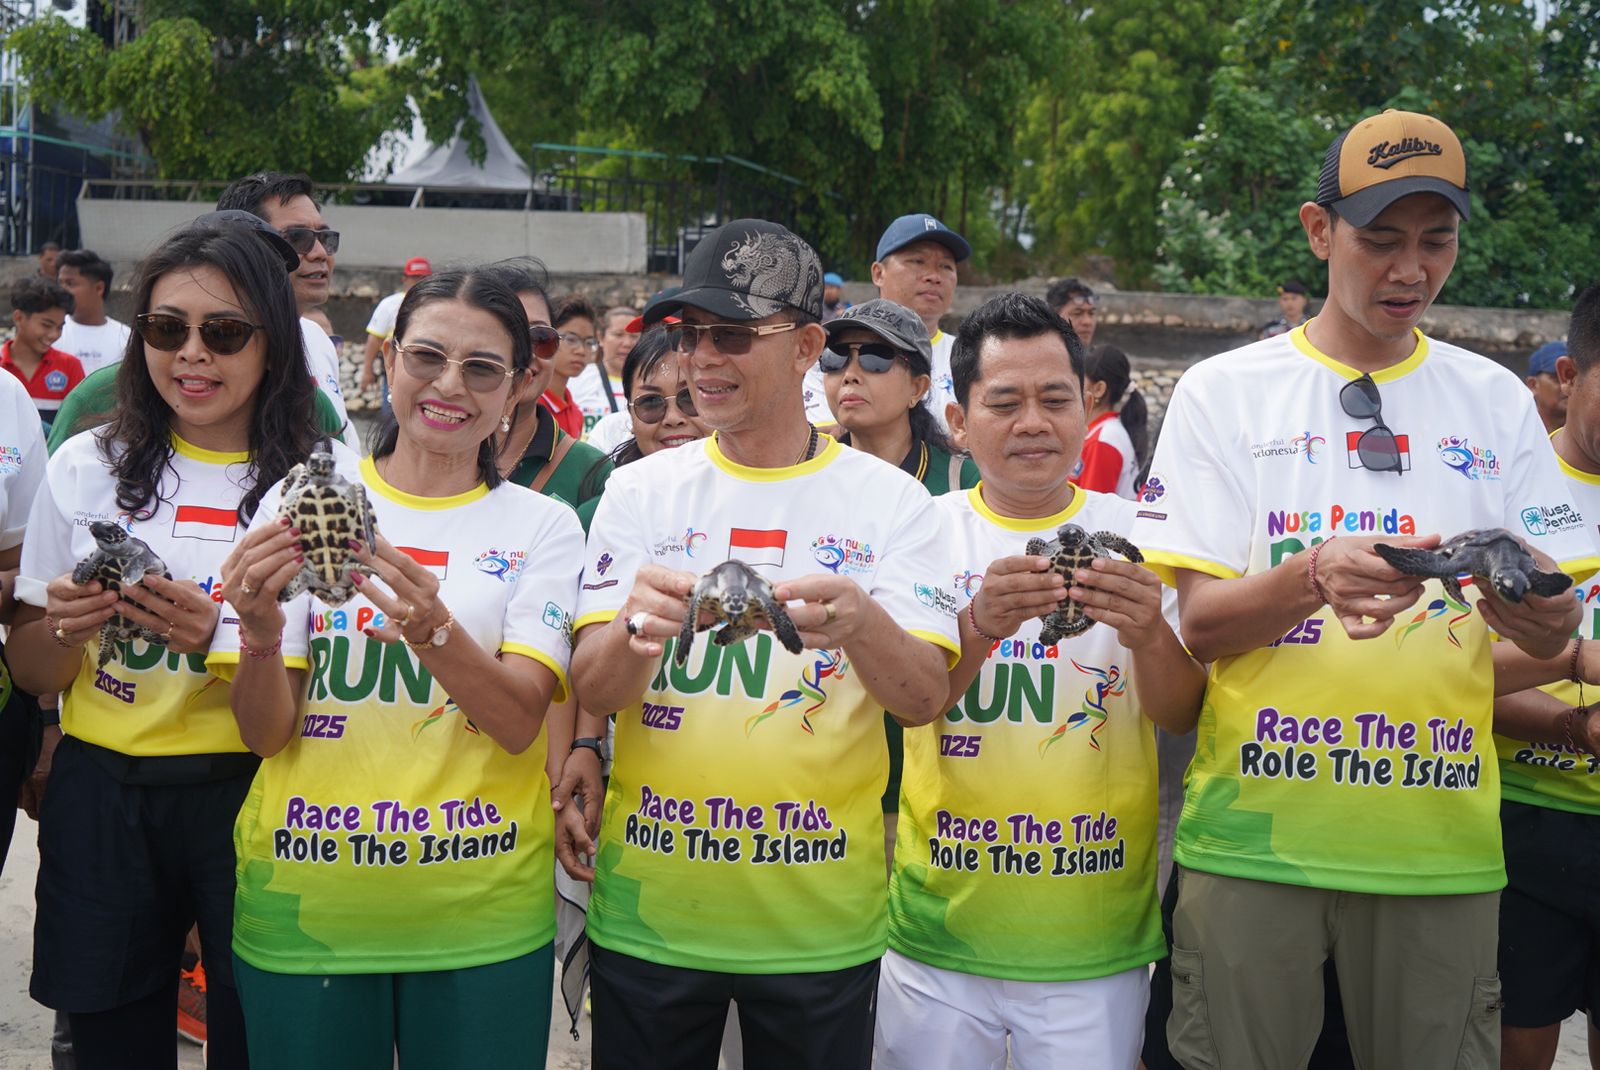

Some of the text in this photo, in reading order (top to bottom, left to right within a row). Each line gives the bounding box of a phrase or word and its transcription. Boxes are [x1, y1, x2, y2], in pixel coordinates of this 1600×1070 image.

[1367, 137, 1443, 165] Kalibre
[73, 510, 110, 520] onderful
[1268, 504, 1415, 537] Nusa Penida
[1541, 503, 1571, 518] Nusa
[1558, 523, 1585, 533] Tomorro
[94, 668, 137, 704] 2025
[308, 635, 434, 705] RUN
[945, 662, 1056, 724] UN
[939, 734, 983, 758] 025
[1256, 707, 1474, 753] Race The Tide
[1240, 742, 1480, 789] Role The Island
[286, 796, 502, 833] Race The Tide
[637, 785, 833, 832] Race The Tide
[936, 809, 1117, 845] Race The Tide
[274, 821, 518, 866] Role The Island
[625, 813, 847, 865] Role The Island
[928, 837, 1124, 876] Role The Island
